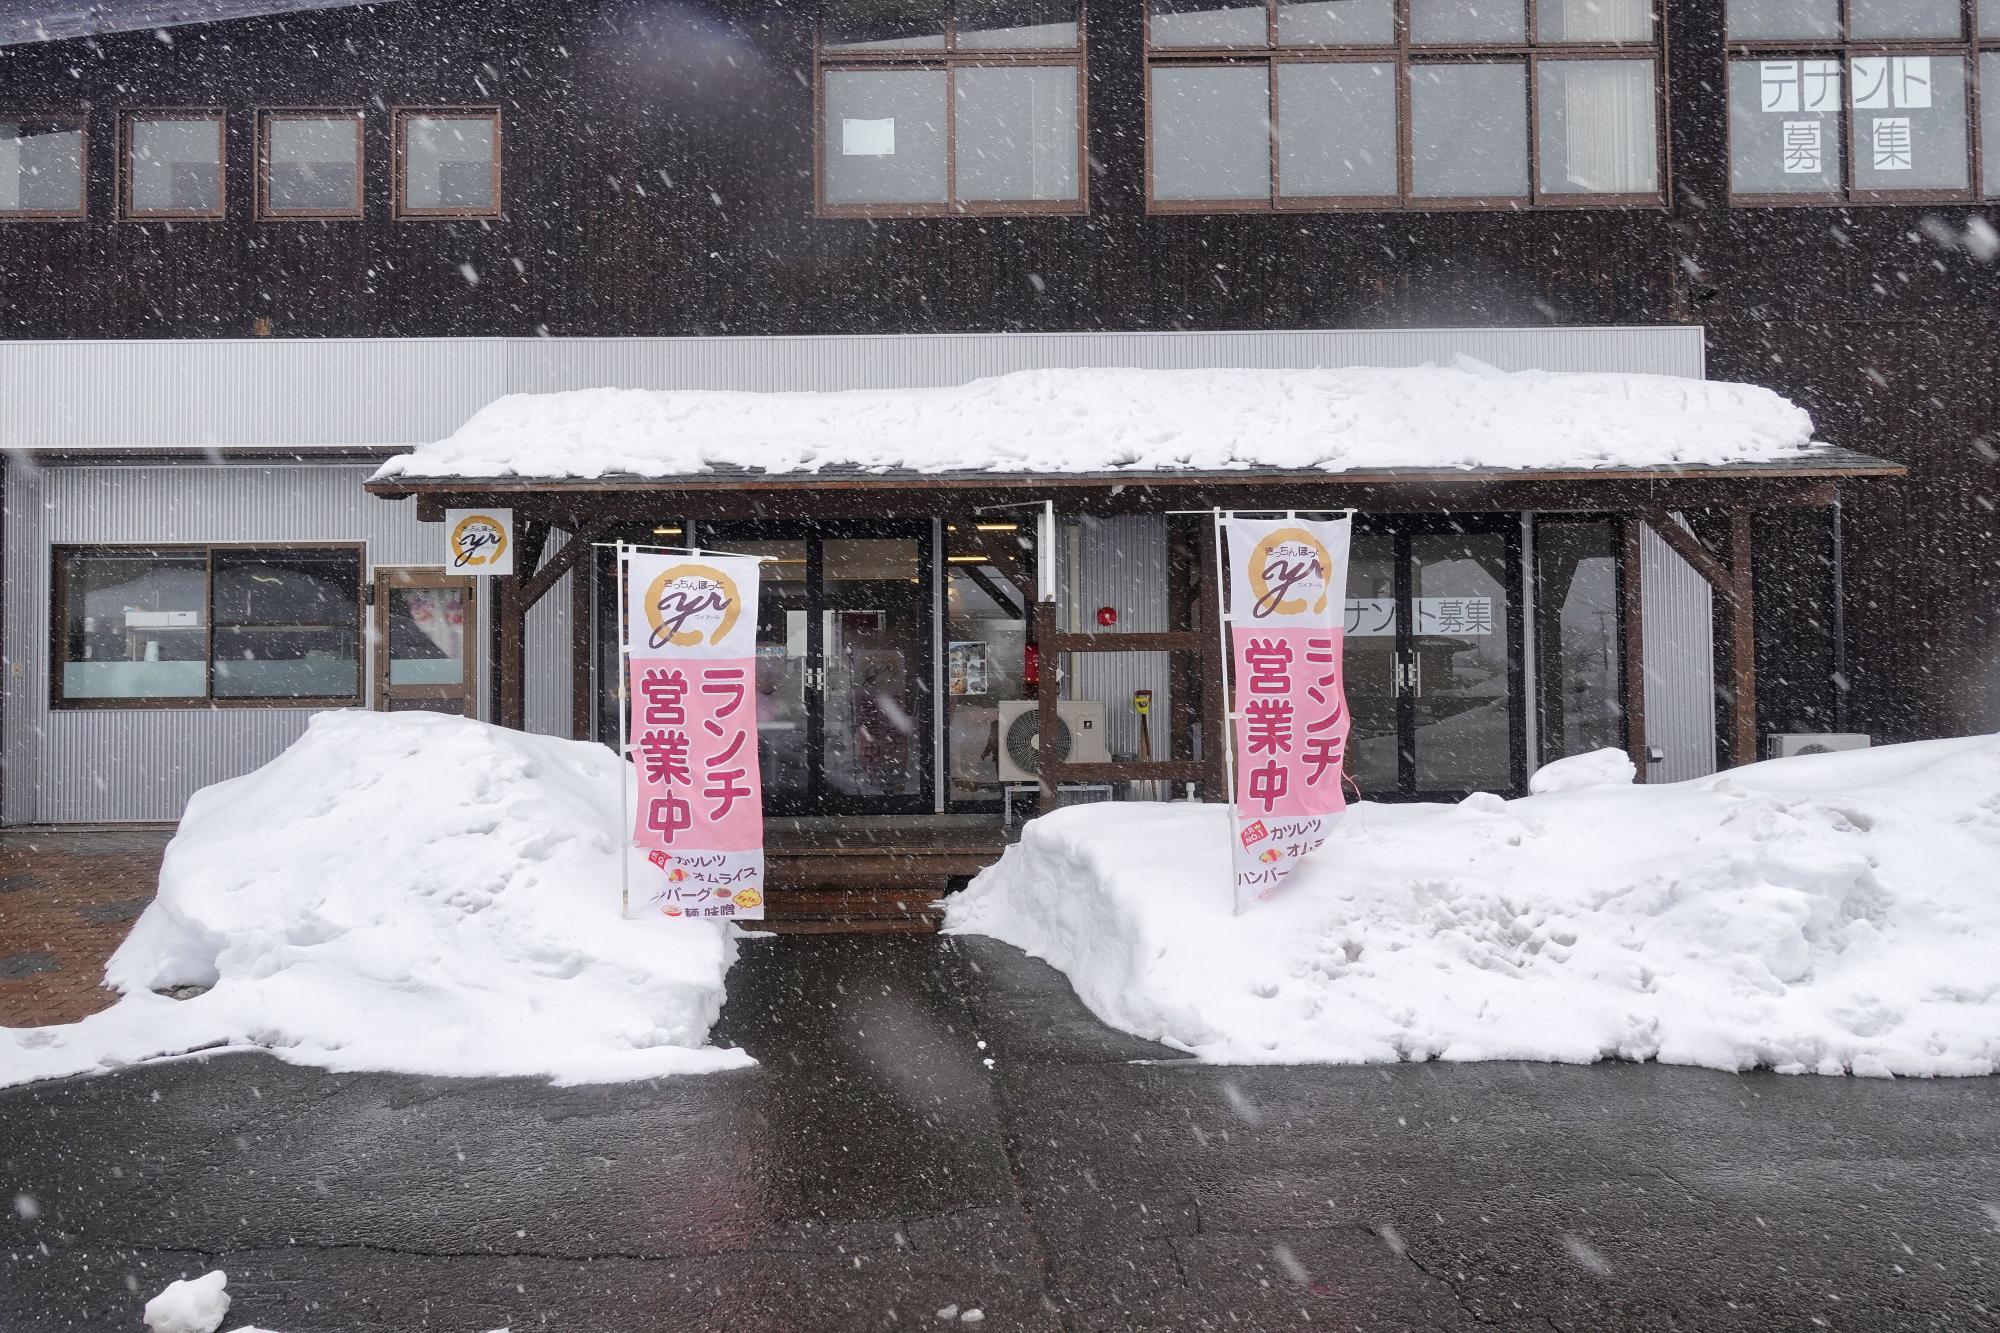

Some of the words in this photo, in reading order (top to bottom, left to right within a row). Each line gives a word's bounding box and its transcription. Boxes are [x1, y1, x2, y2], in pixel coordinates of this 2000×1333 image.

[1762, 60, 1927, 108] テナント
[1784, 121, 1910, 169] 募集
[664, 579, 724, 590] きっちんほっと
[702, 669, 751, 820] ランチ
[1245, 638, 1293, 812] 営業中
[640, 668, 692, 844] 営業中
[1270, 819, 1321, 841] カツレツ
